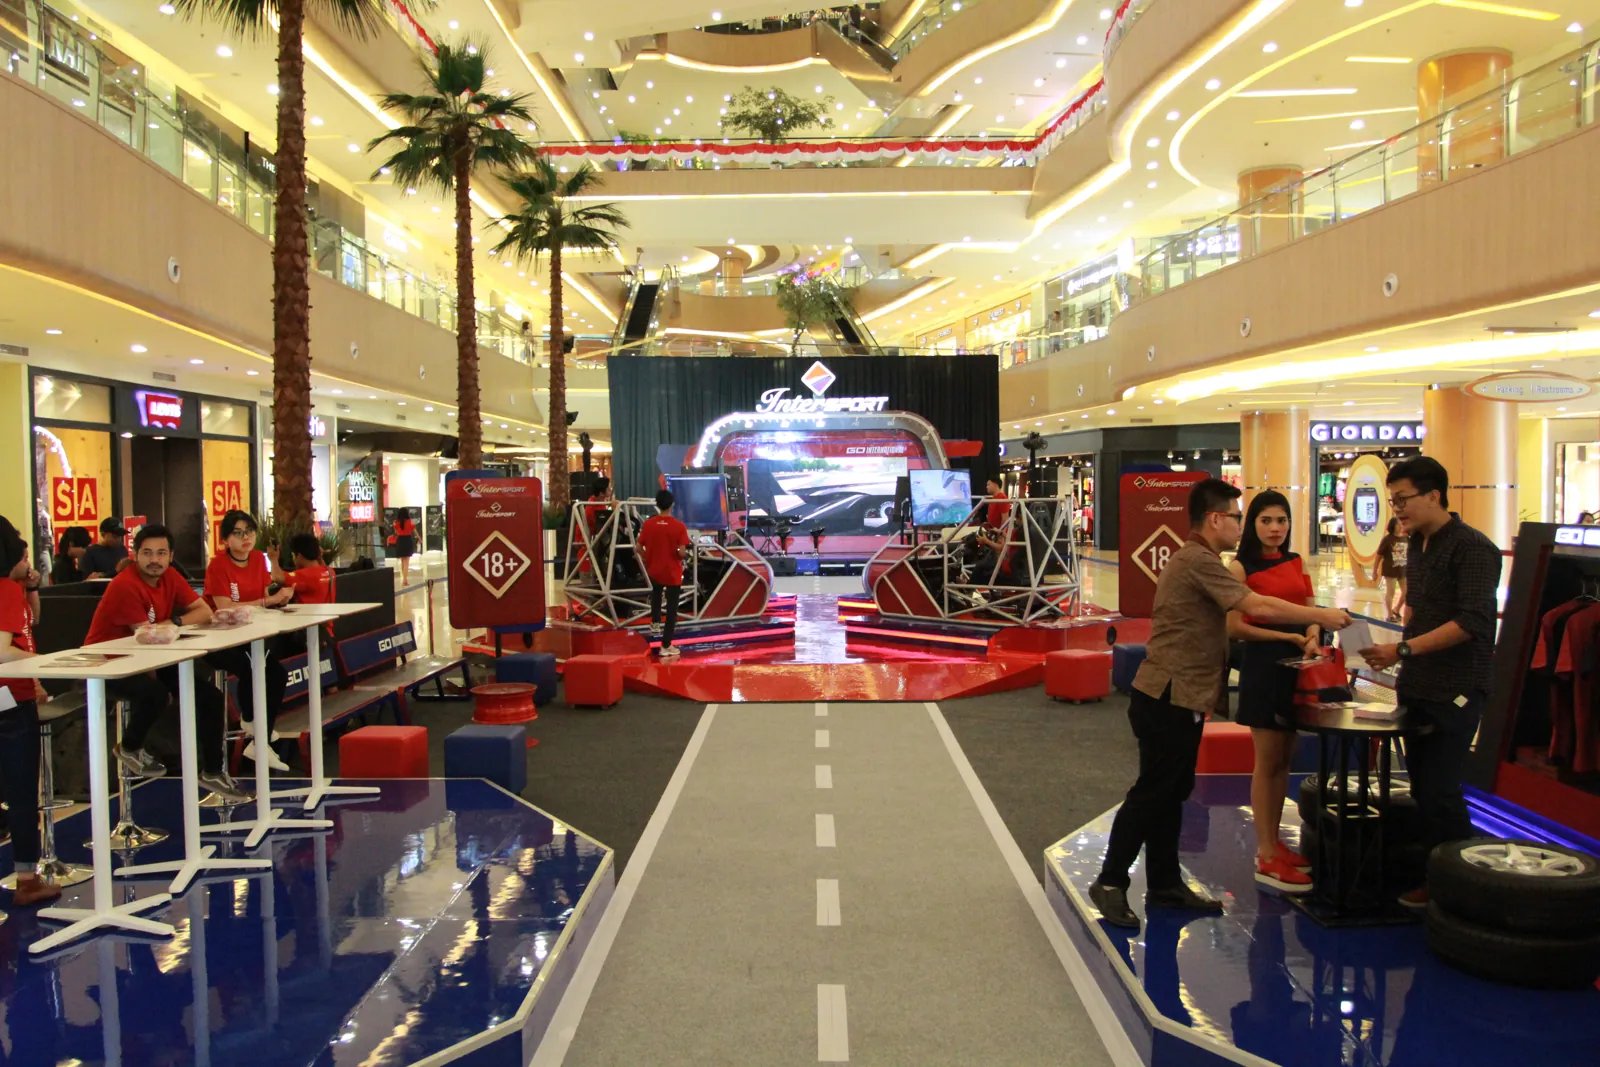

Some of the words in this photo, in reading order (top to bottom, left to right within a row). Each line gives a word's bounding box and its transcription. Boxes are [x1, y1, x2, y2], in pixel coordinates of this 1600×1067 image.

[1496, 385, 1523, 396] Parking
[1536, 385, 1575, 394] Restrooms
[350, 486, 373, 500] SPENCER
[481, 552, 518, 578] 18+
[378, 638, 391, 652] GO
